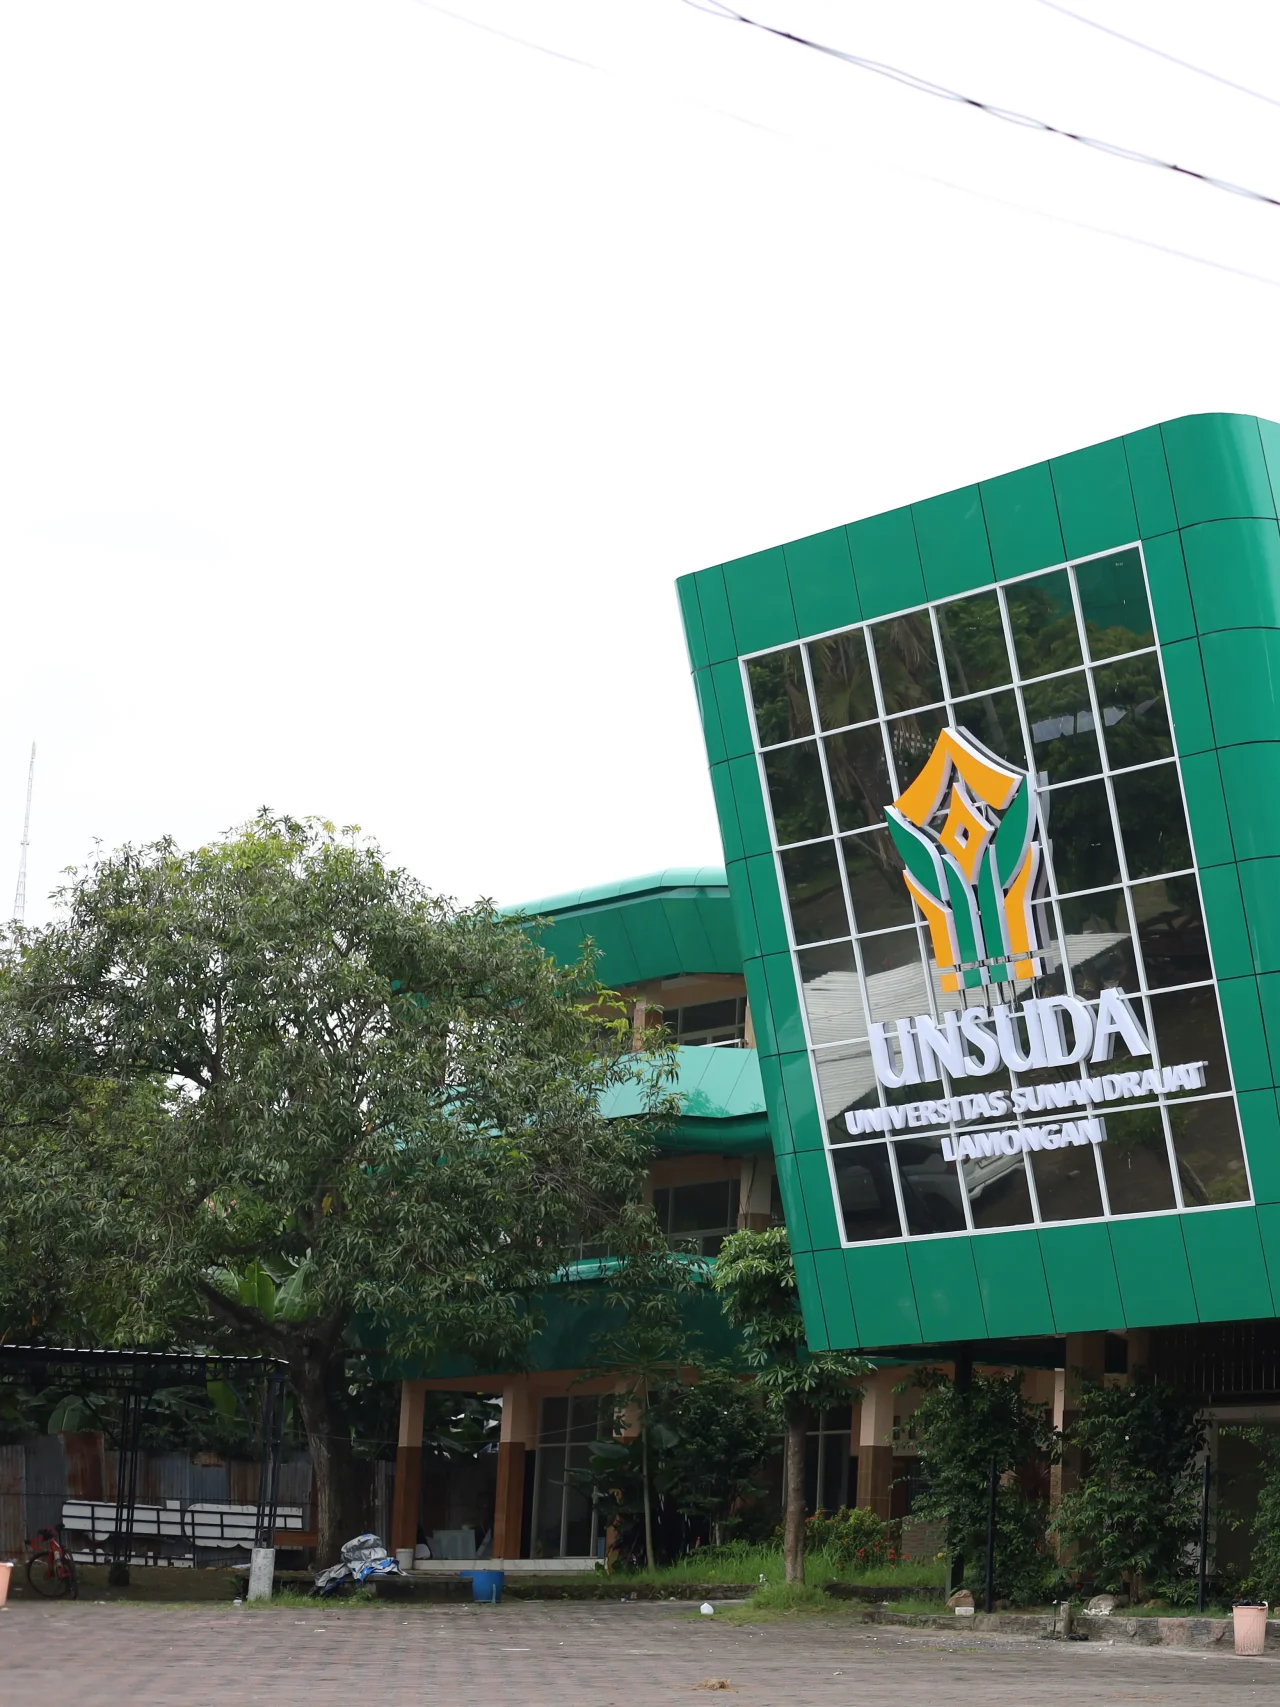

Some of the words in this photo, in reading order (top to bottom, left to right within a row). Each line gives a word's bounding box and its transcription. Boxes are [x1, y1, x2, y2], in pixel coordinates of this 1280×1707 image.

[868, 986, 1152, 1089] UNSUDA
[844, 1090, 1012, 1135] UNIVERSITAS
[940, 1117, 1107, 1162] LAMONGAN
